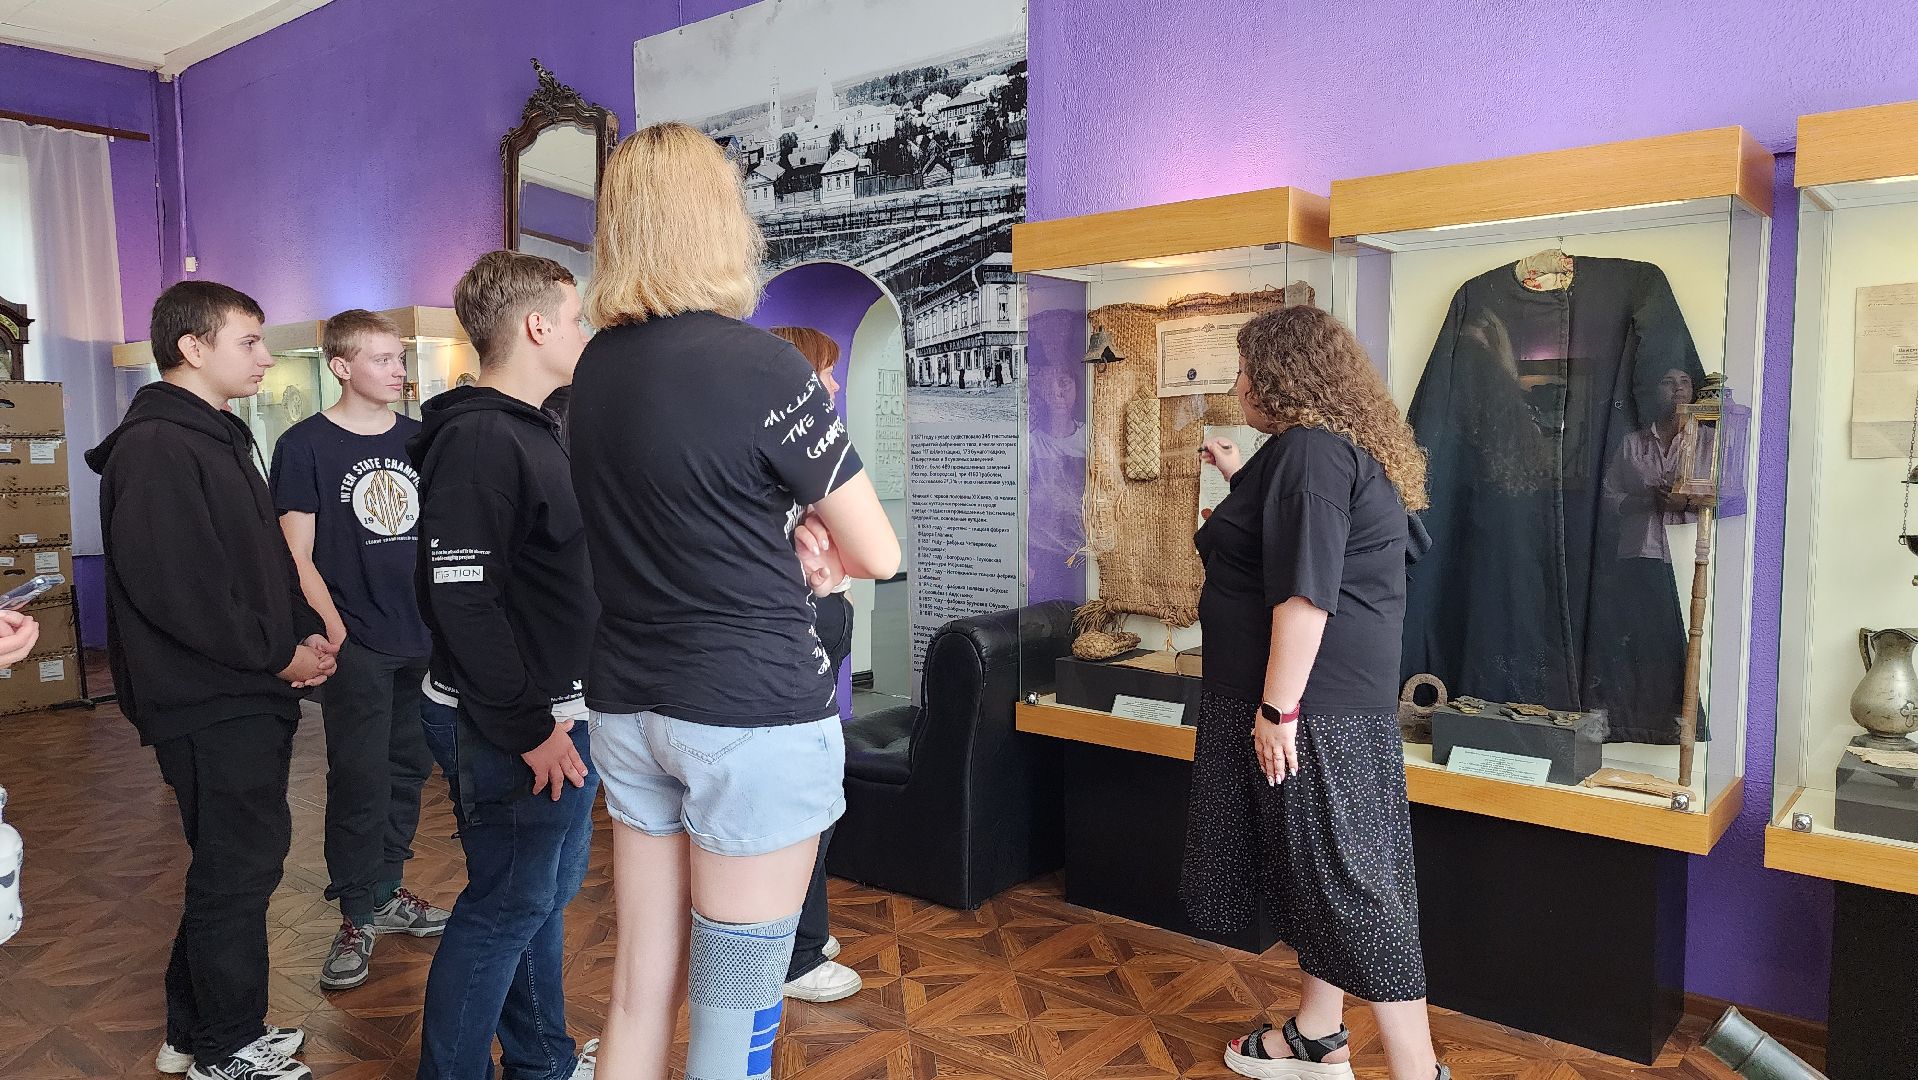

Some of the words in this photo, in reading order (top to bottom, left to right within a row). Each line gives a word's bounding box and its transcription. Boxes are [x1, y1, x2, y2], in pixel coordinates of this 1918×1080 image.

[781, 413, 815, 445] THE
[340, 472, 358, 503] INTER
[352, 458, 382, 475] STATE
[364, 517, 374, 525] 19
